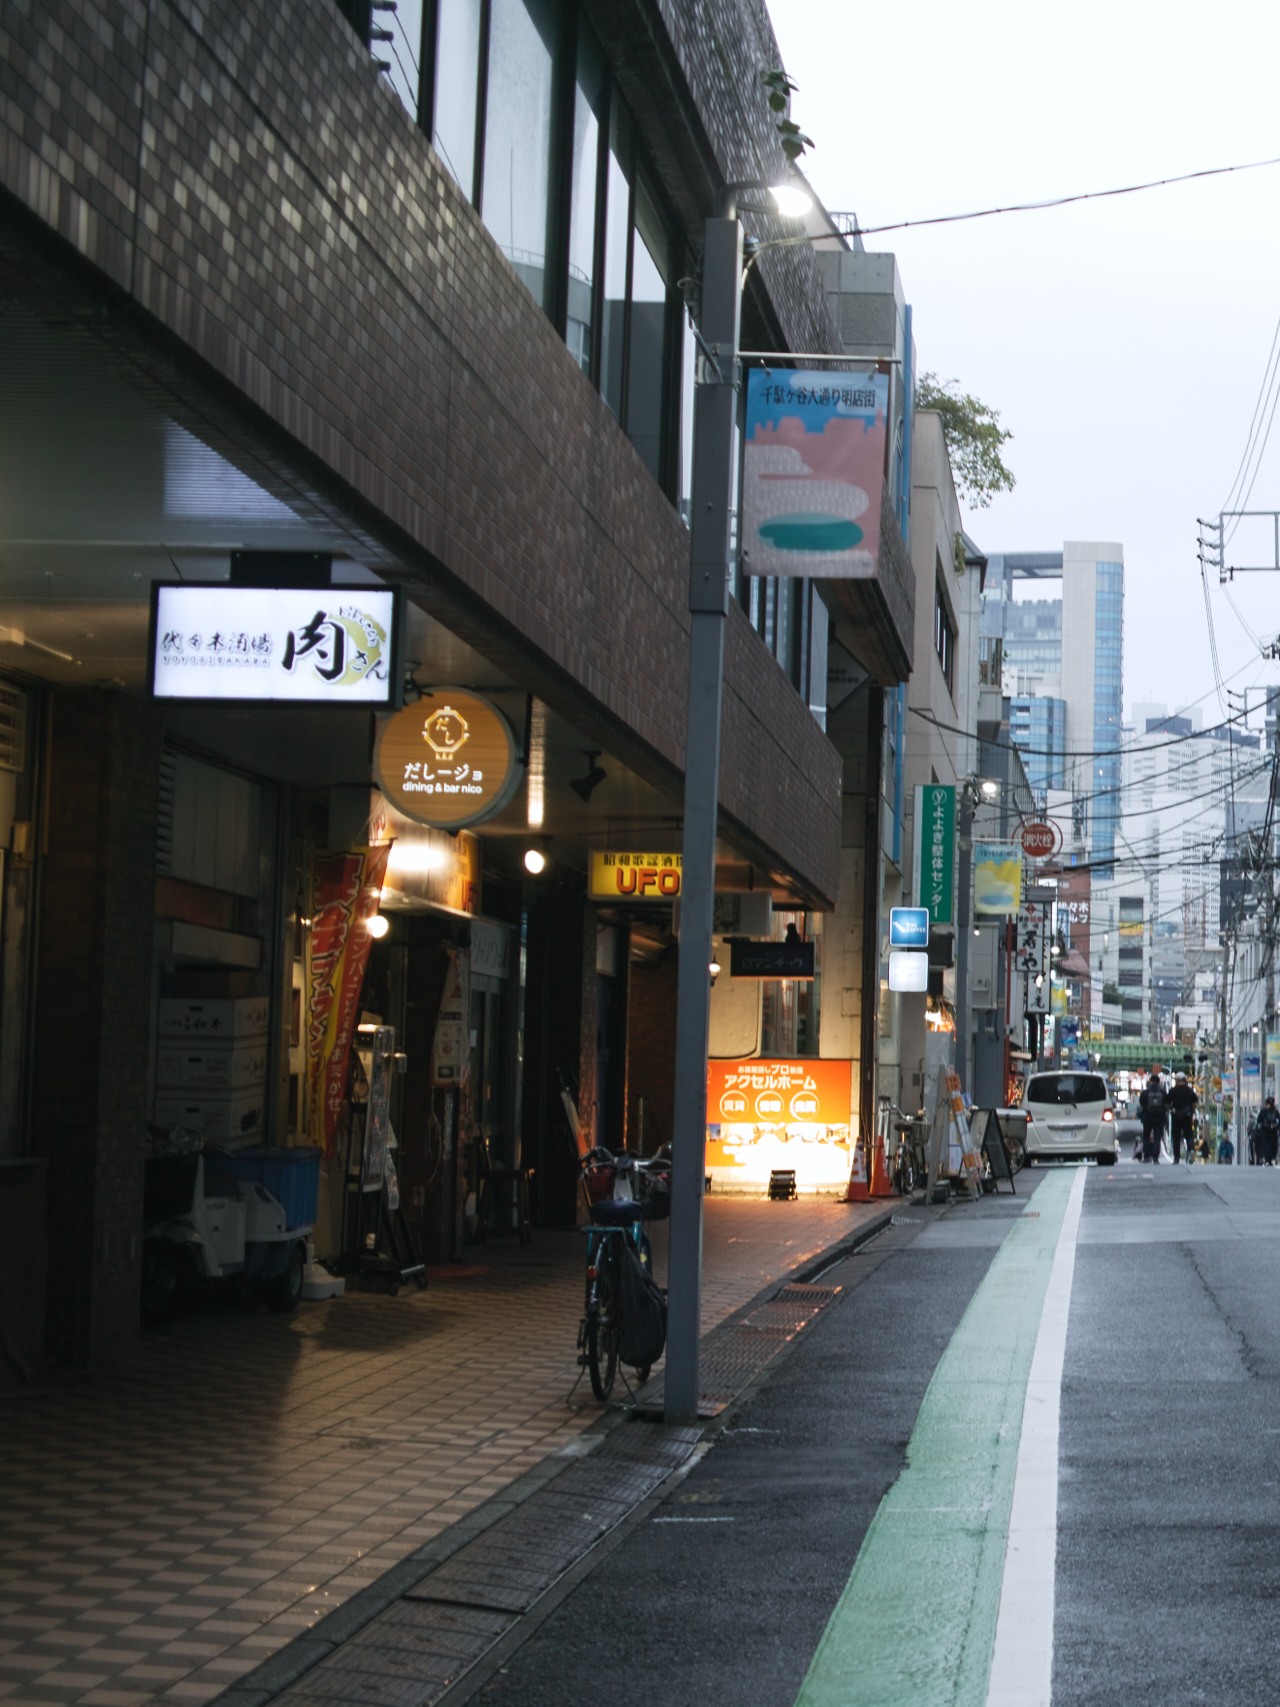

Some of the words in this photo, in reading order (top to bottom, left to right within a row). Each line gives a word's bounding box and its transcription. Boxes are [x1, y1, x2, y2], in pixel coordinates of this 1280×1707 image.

[760, 386, 876, 407] 千駄ヶ谷大通り明店街
[161, 631, 271, 653] 代々木酒場
[281, 609, 345, 681] 肉
[351, 649, 388, 680] さん
[436, 717, 455, 745] だし
[403, 762, 483, 782] だしージョ
[402, 781, 433, 794] dining
[435, 783, 443, 793] &
[443, 783, 460, 794] bar
[461, 784, 483, 795] nico
[1023, 832, 1053, 848] 消火栓
[616, 867, 681, 895] UFO
[724, 1075, 817, 1090] アクセルホーム
